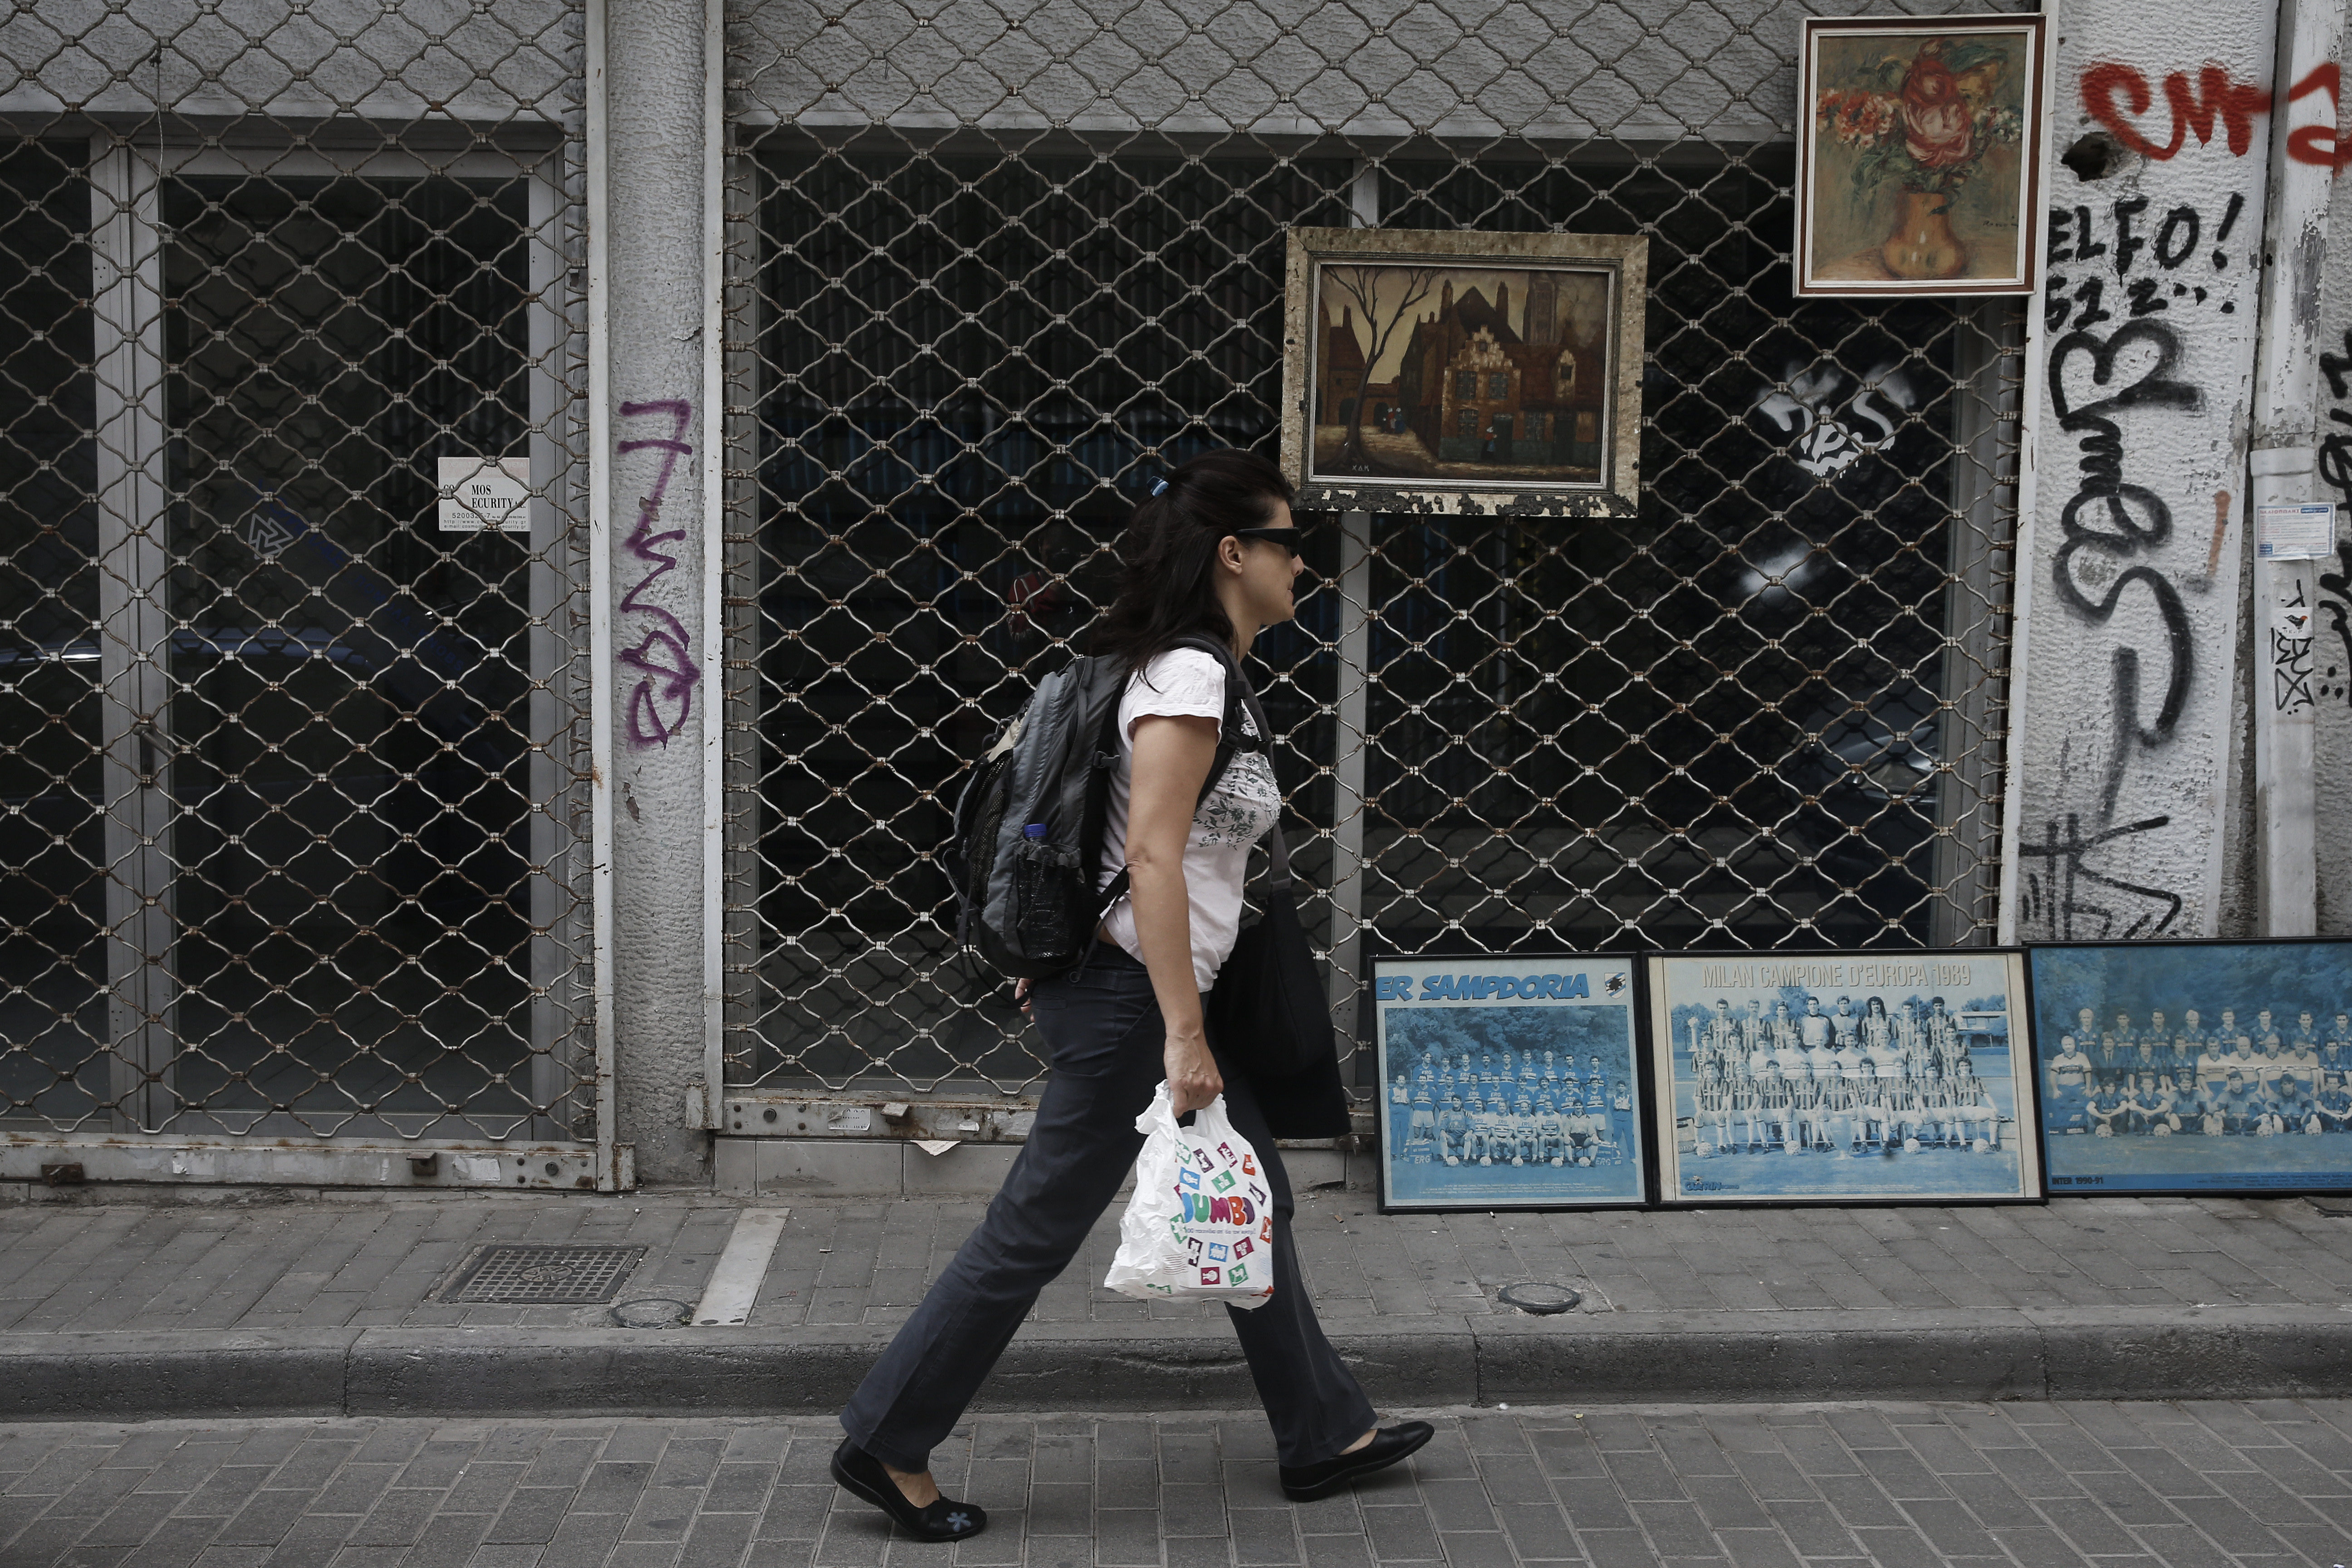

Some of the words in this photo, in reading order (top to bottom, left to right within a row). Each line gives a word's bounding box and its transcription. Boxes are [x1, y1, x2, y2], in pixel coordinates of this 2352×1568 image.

[1703, 965, 1754, 988] MILAN
[1760, 964, 1843, 988] CAMPIONE
[1848, 963, 1929, 988] D'EUROPA
[1932, 963, 1971, 987] 1989
[1419, 973, 1590, 1001] SAMPDORIA
[1414, 1155, 1431, 1164] ERG
[1596, 1157, 1611, 1166] ERG
[2052, 1177, 2072, 1185] INTER
[1181, 1192, 1255, 1226] JUMBO
